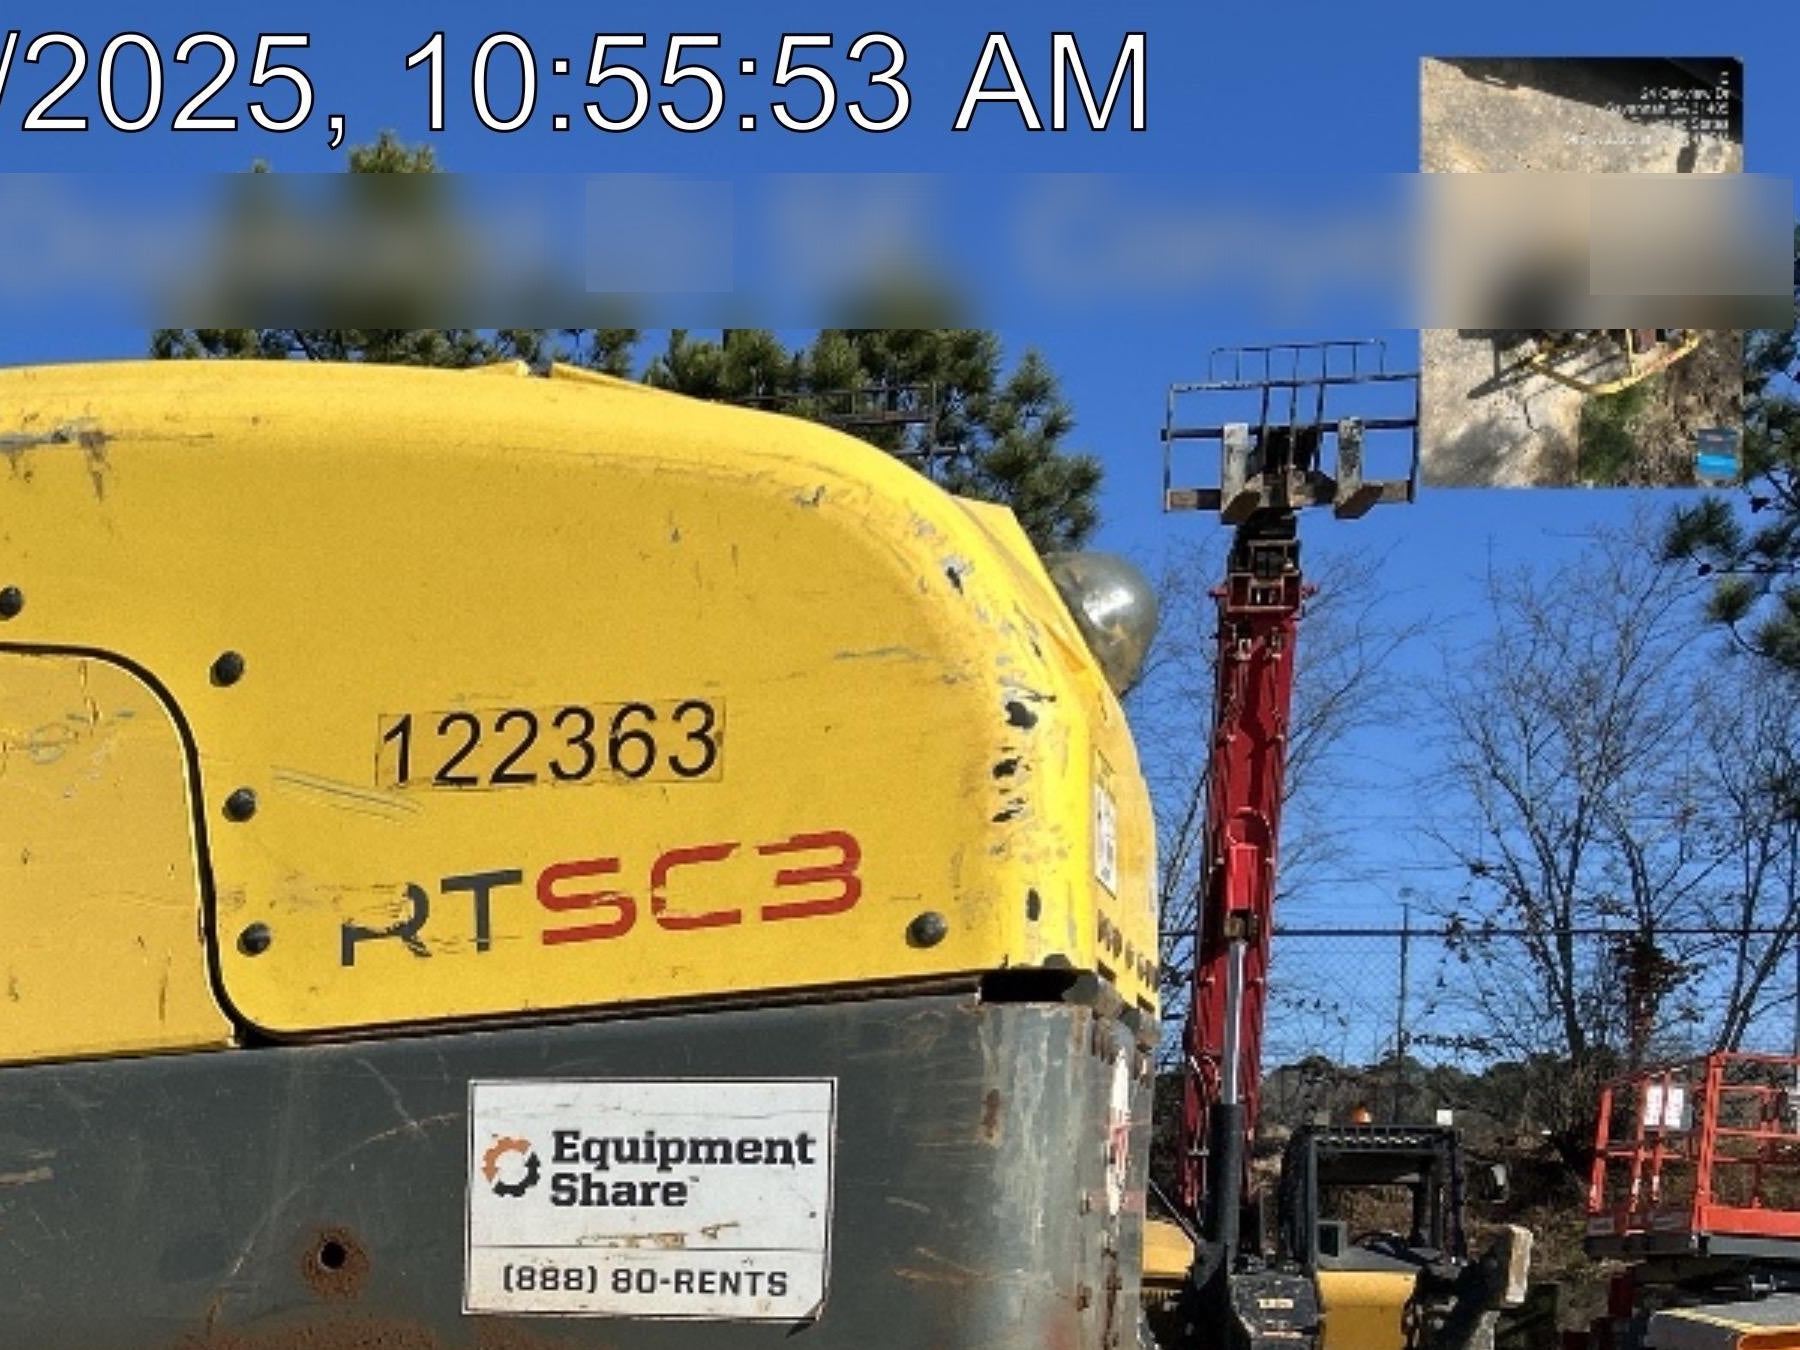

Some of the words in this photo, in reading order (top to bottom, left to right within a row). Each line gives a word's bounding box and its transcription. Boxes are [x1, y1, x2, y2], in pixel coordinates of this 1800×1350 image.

[382, 700, 718, 786] 122363
[551, 1130, 817, 1172] Equipment
[550, 1173, 688, 1208] Share
[504, 1265, 598, 1294] (888)
[612, 1269, 789, 1297] 80-RENTS
